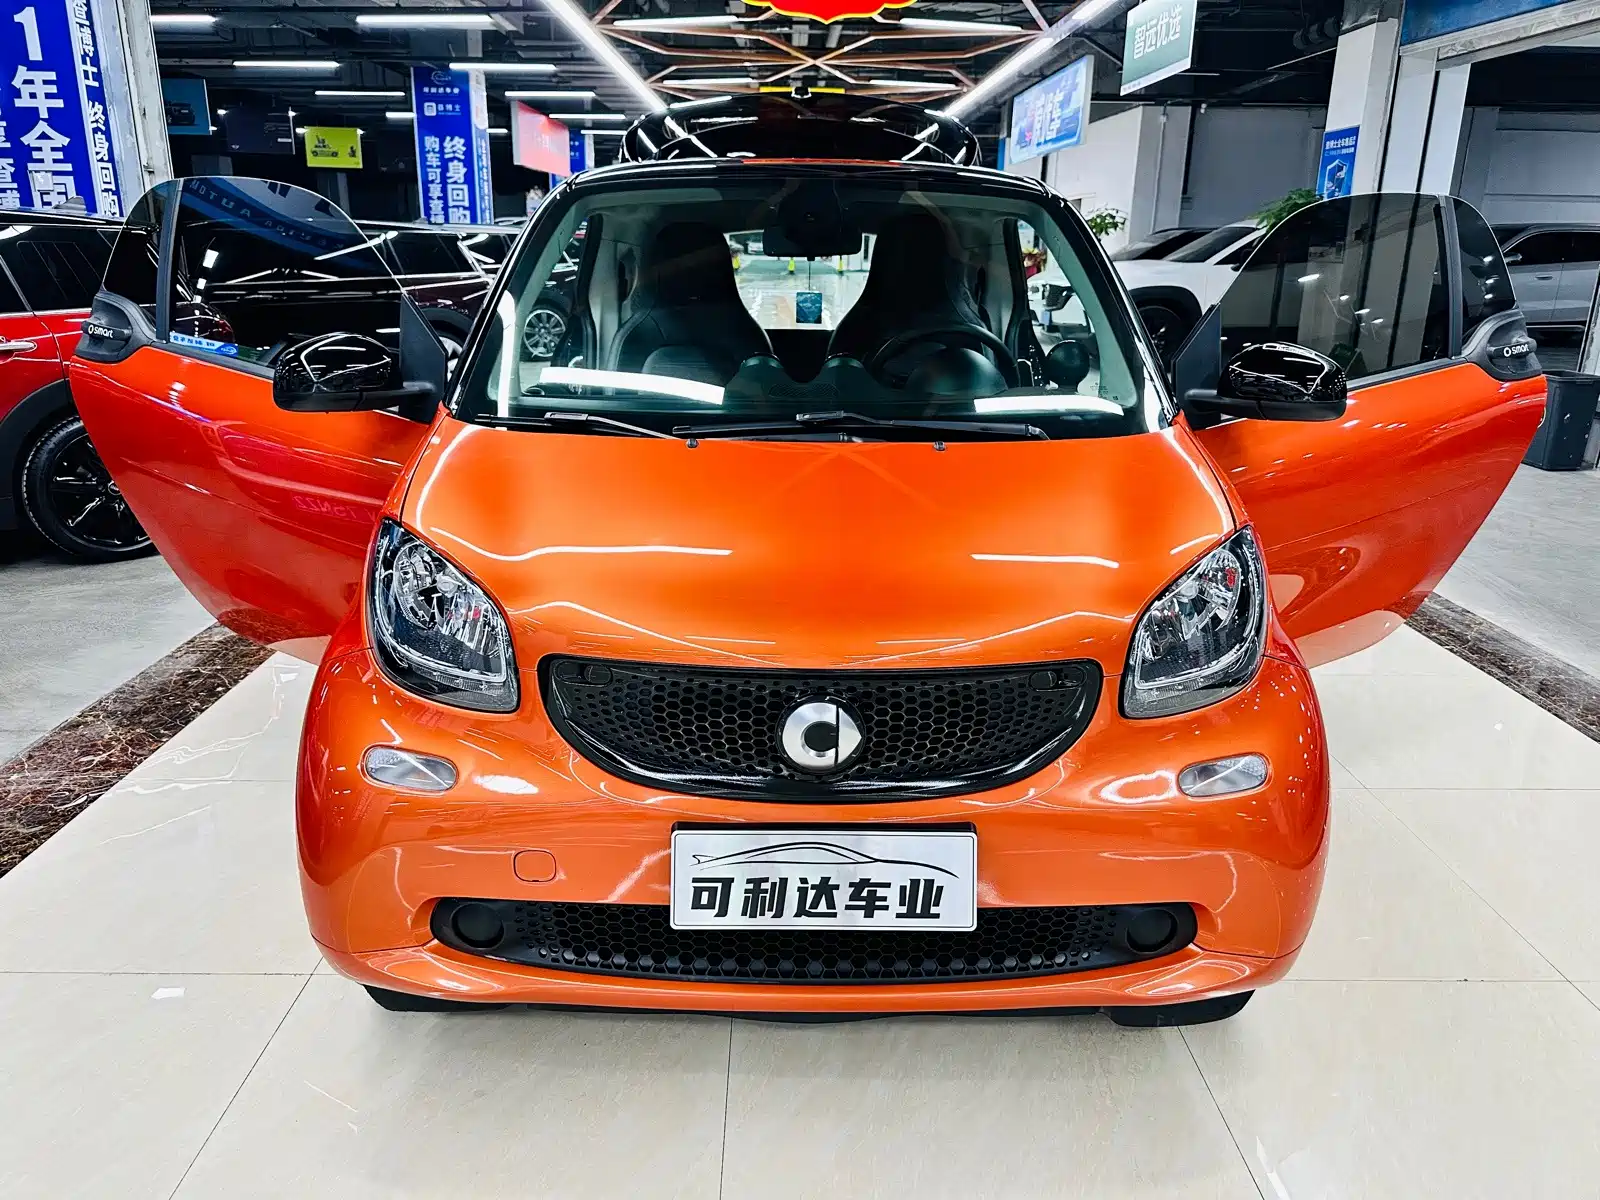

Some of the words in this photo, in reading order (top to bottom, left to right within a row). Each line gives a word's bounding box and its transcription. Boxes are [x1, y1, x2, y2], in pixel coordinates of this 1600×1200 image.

[1134, 3, 1182, 60] 智远优选
[87, 100, 120, 217] 终身回购
[443, 135, 470, 224] 终身回购
[94, 326, 114, 339] smart
[1511, 343, 1529, 355] smart
[690, 876, 945, 919] 可利达车业
